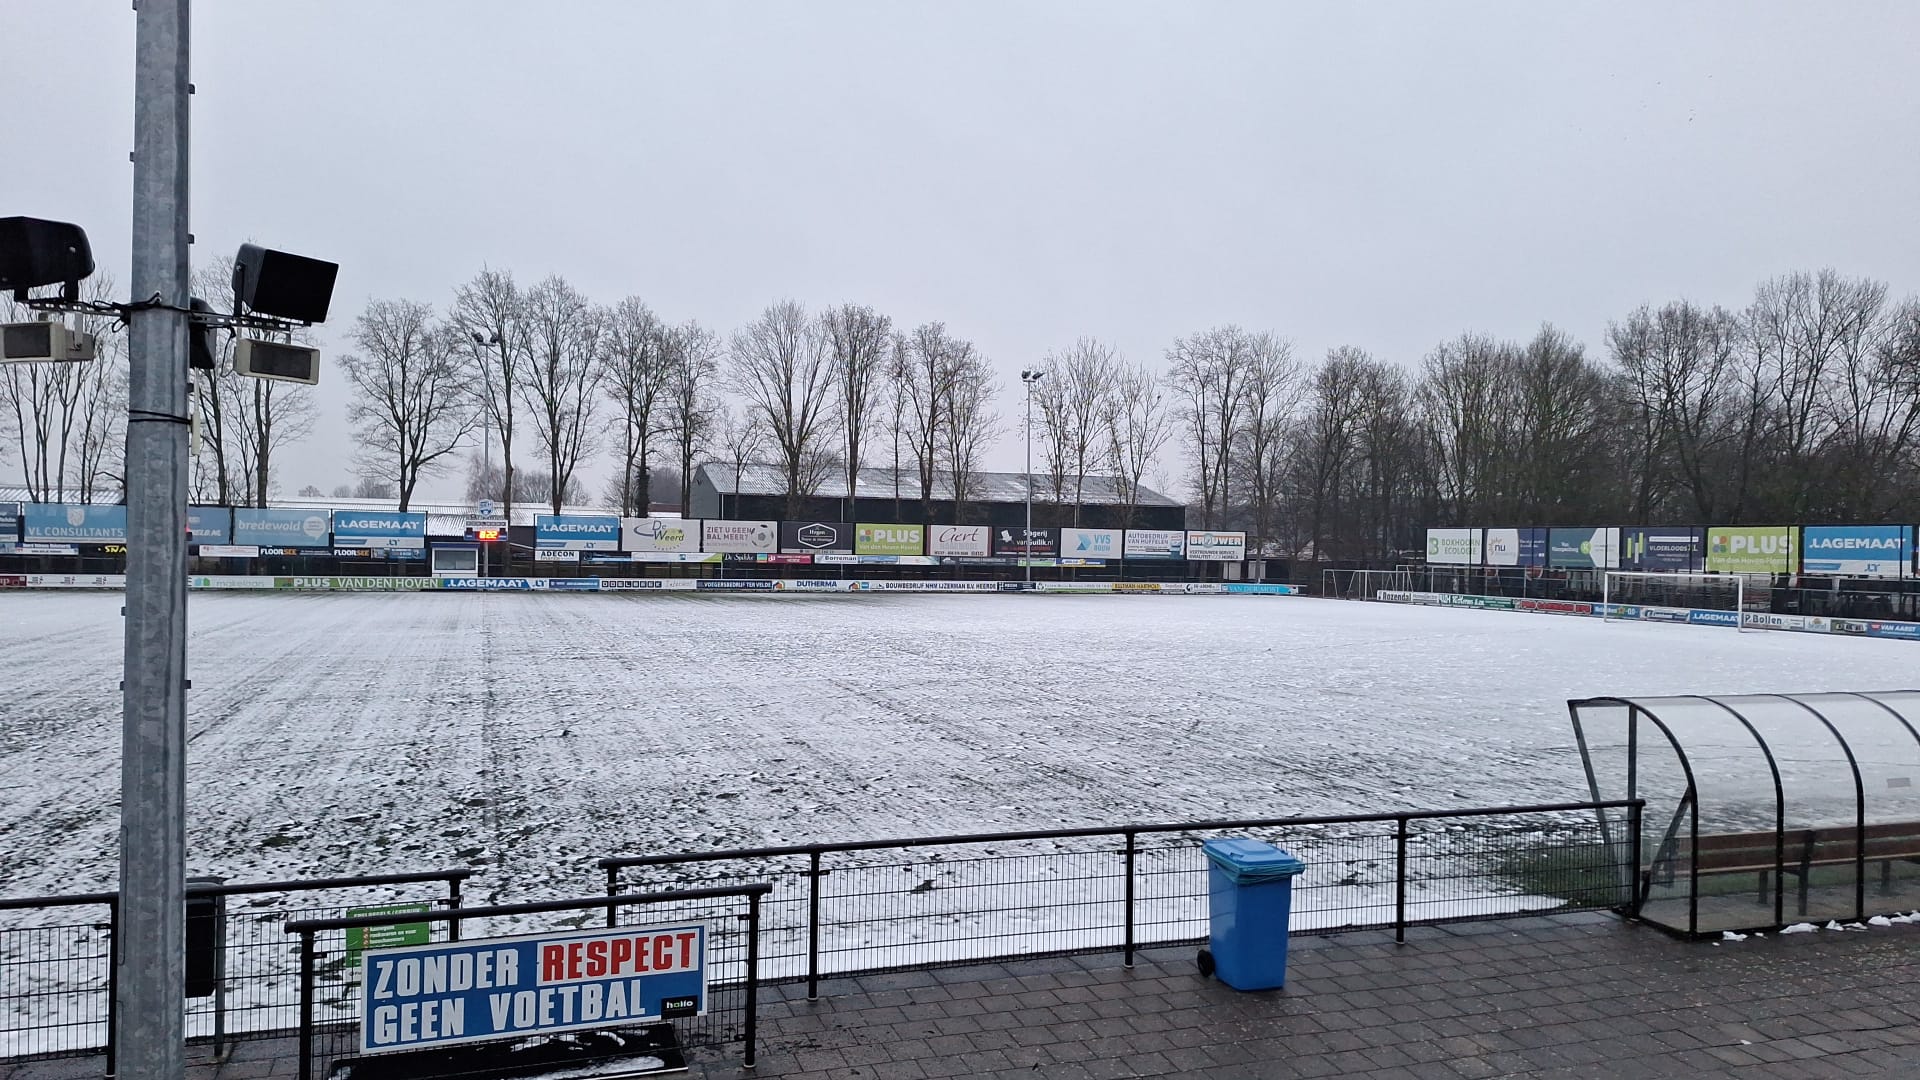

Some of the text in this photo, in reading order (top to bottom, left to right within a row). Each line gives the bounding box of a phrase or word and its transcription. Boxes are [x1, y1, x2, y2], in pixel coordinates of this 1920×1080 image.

[238, 520, 300, 531] bredewold
[338, 520, 419, 529] LAGEMAAT
[540, 524, 613, 533] LAGEMAAT
[652, 520, 667, 531] De
[28, 527, 124, 537] VL CONSULTANTS
[653, 530, 684, 542] Weerd
[873, 529, 920, 543] PLUS
[1094, 535, 1111, 544] VVS
[1730, 535, 1794, 554] PLUS
[1809, 538, 1906, 549] LAGEMAAT
[1444, 547, 1476, 555] ECOLOGE
[1494, 544, 1506, 552] nu
[293, 578, 438, 588] PLUS VAN DEN HOVEN
[447, 579, 526, 588] LAGEMAAT
[374, 932, 696, 1000] ZONDER RESPECT
[666, 998, 694, 1010] hallo
[373, 979, 646, 1044] GEEN VOETBAL
